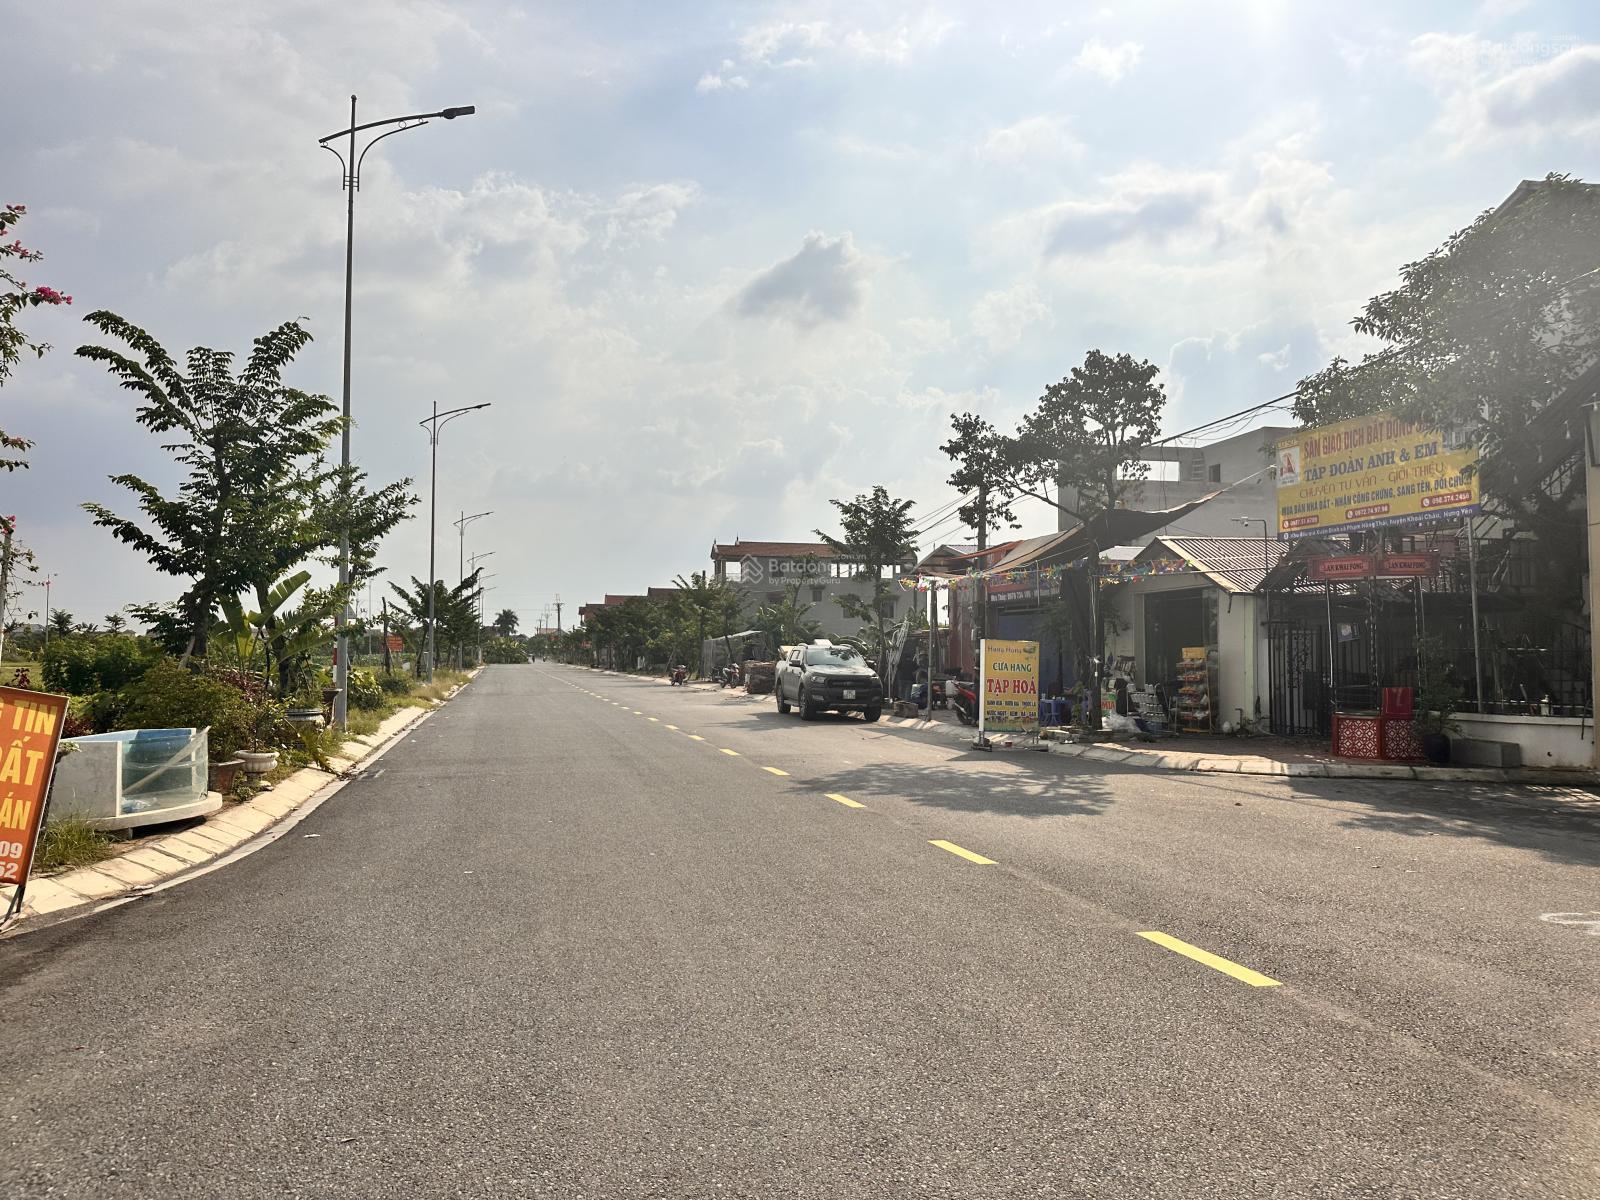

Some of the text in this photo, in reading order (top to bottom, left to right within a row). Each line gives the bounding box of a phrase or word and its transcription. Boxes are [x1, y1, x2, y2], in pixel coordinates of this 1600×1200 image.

[1322, 432, 1341, 455] GIAO
[1330, 456, 1364, 477] ĐOÀN
[1367, 450, 1396, 468] ANH
[1400, 447, 1410, 462] &
[1414, 441, 1438, 460] EM
[1396, 483, 1415, 497] SANG
[986, 678, 1010, 697] TẠP
[12, 699, 58, 736] TIN
[0, 736, 45, 786] ẤT
